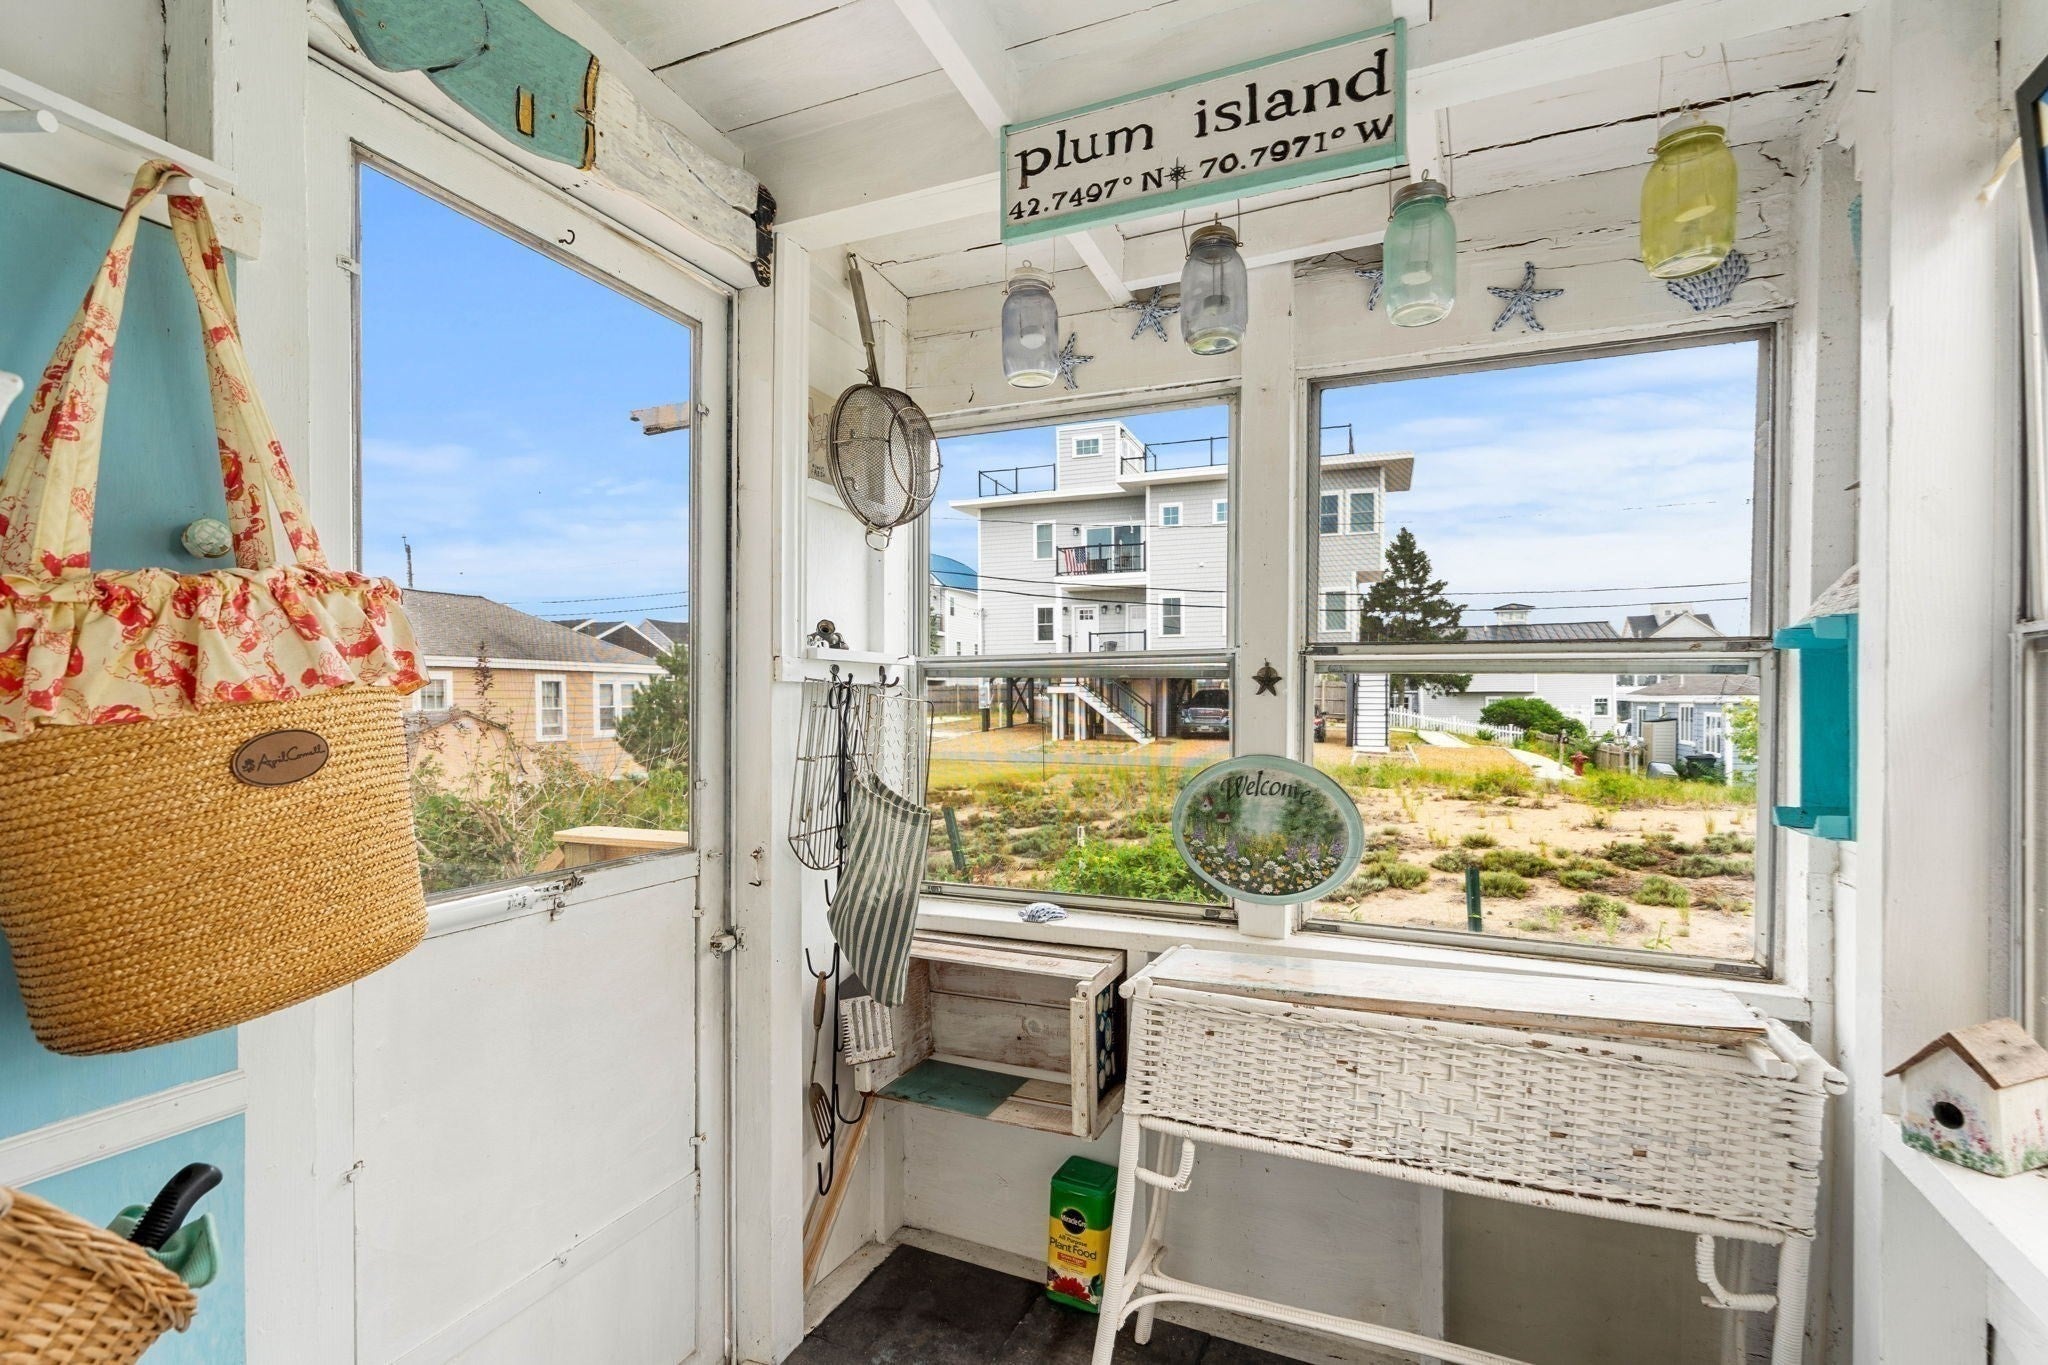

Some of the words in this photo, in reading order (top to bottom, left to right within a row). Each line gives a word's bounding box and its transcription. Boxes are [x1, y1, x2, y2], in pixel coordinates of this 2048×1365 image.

[1016, 122, 1154, 190] plum
[1194, 47, 1391, 139] island
[1008, 176, 1133, 220] 42.7497°
[1141, 166, 1164, 192] N
[1198, 126, 1346, 179] 70.7971°
[1354, 113, 1395, 144] W
[256, 751, 289, 772] April
[1219, 769, 1312, 805] Welcome
[1049, 1236, 1072, 1253] Plant
[1072, 1244, 1097, 1261] Food
